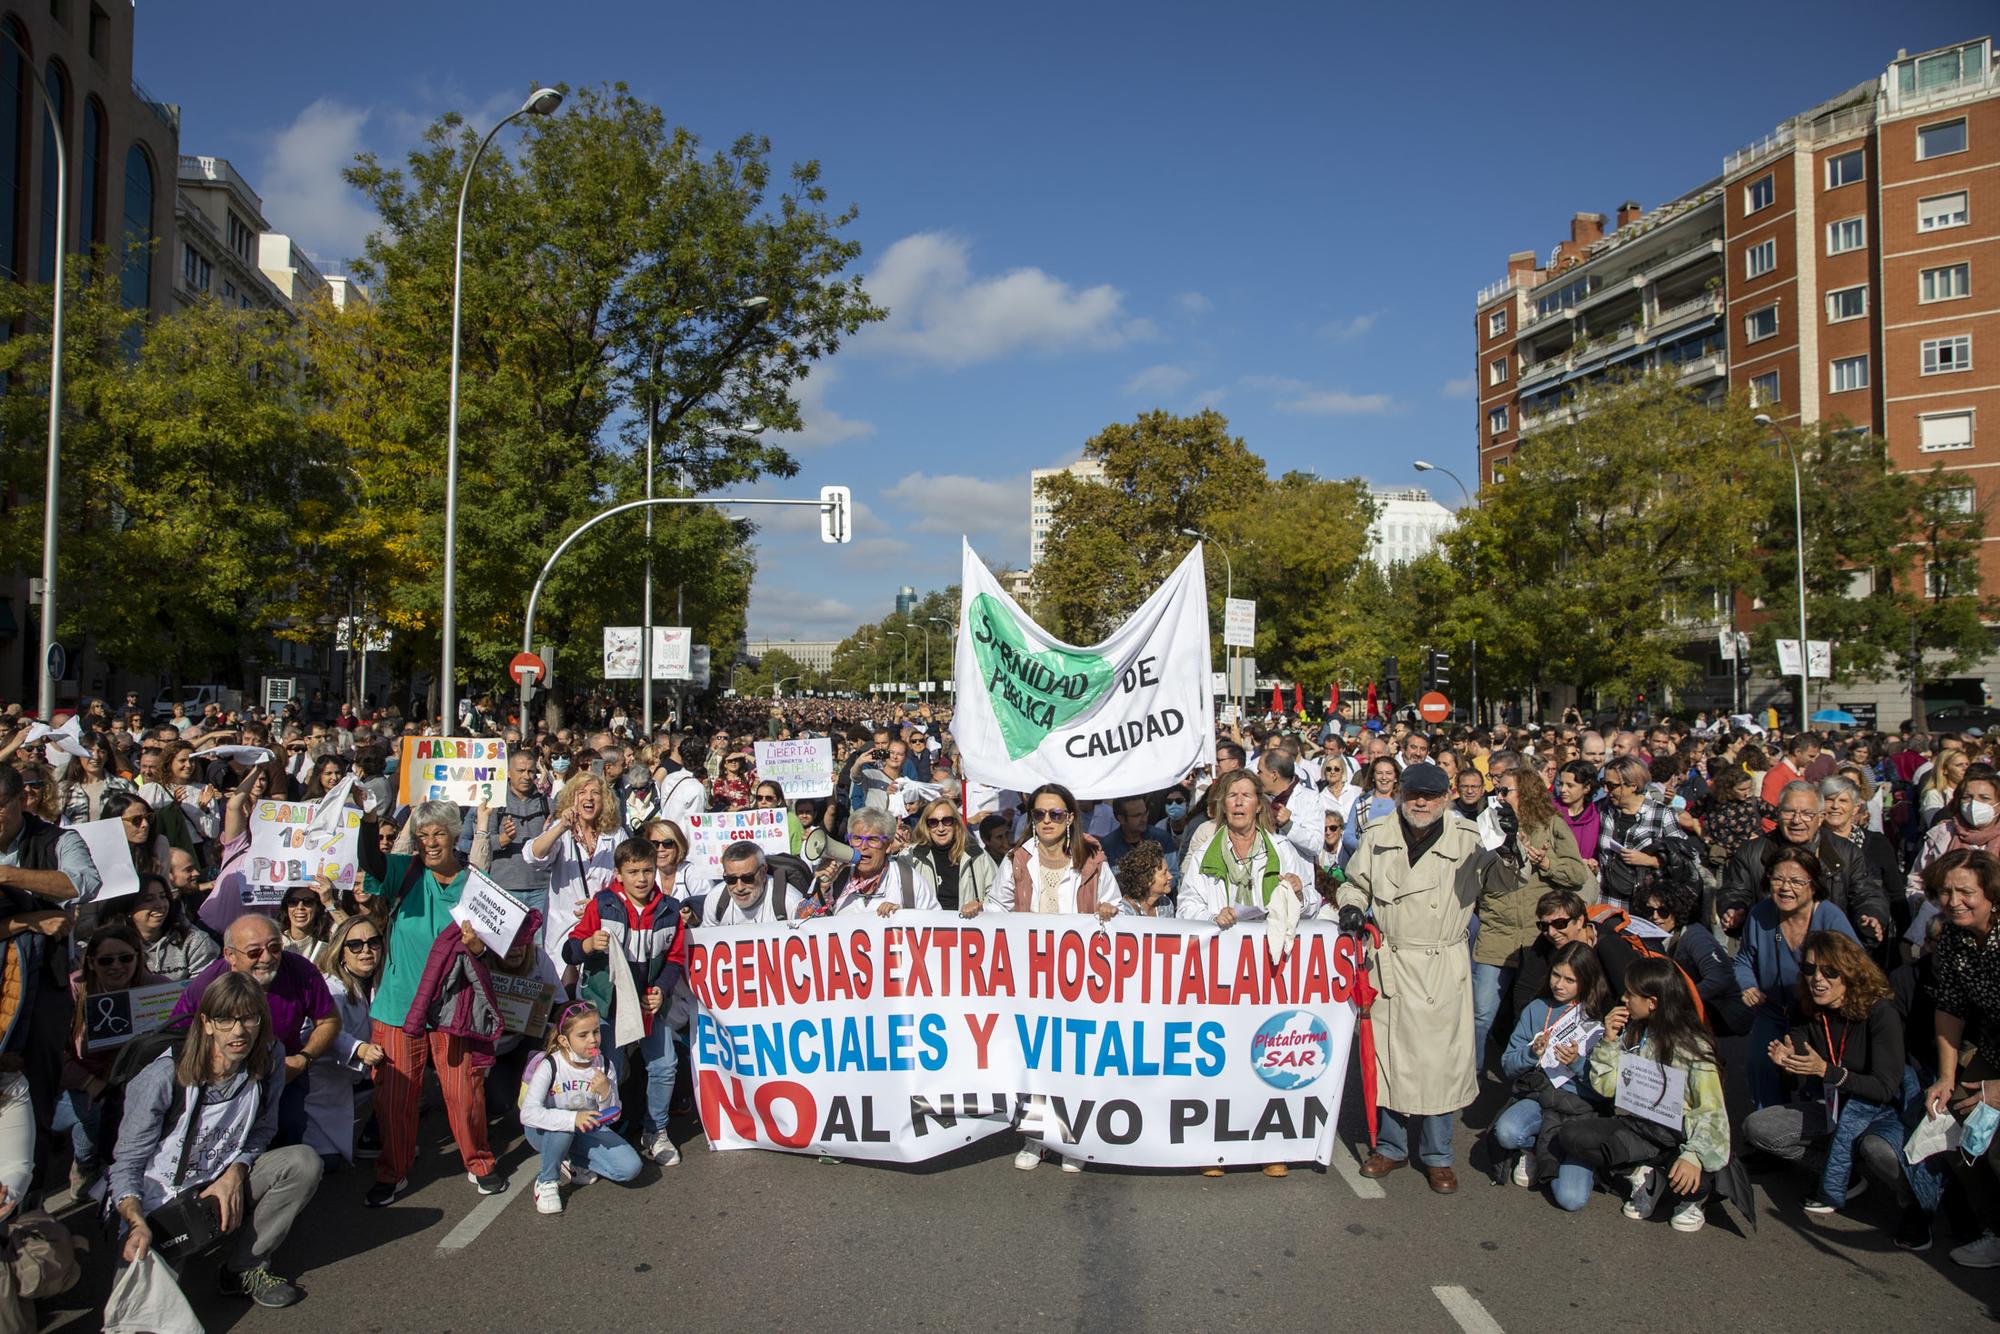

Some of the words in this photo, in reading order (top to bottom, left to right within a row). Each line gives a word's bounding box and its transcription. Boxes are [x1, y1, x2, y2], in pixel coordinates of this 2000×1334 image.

[1122, 655, 1159, 694] DE
[1066, 708, 1184, 758] CALIDAD
[417, 740, 485, 759] MADRID
[487, 742, 506, 760] SE
[767, 746, 816, 758] LIBERTAD
[423, 763, 505, 782] LEVANTA
[429, 784, 449, 801] EL
[259, 802, 362, 829] SANID
[690, 815, 712, 828] UN
[479, 891, 507, 916] SANIDAD
[468, 903, 502, 935] UNIVERSAL
[688, 929, 873, 1010] RGENCIAS
[884, 926, 1016, 997] EXTRA
[1028, 929, 1355, 1005] HOSPITALARIAS
[698, 1013, 948, 1076] ESENCIALES
[963, 1013, 1000, 1070] Y
[1014, 1014, 1226, 1078] VITALES
[1254, 1029, 1327, 1048] Plataforma
[1263, 1050, 1316, 1067] SAR
[699, 1070, 818, 1149] NO
[820, 1095, 891, 1142] AL
[910, 1092, 1143, 1145] NUEVO
[1169, 1096, 1329, 1144] PLAN
[160, 1233, 189, 1249] VONYX
